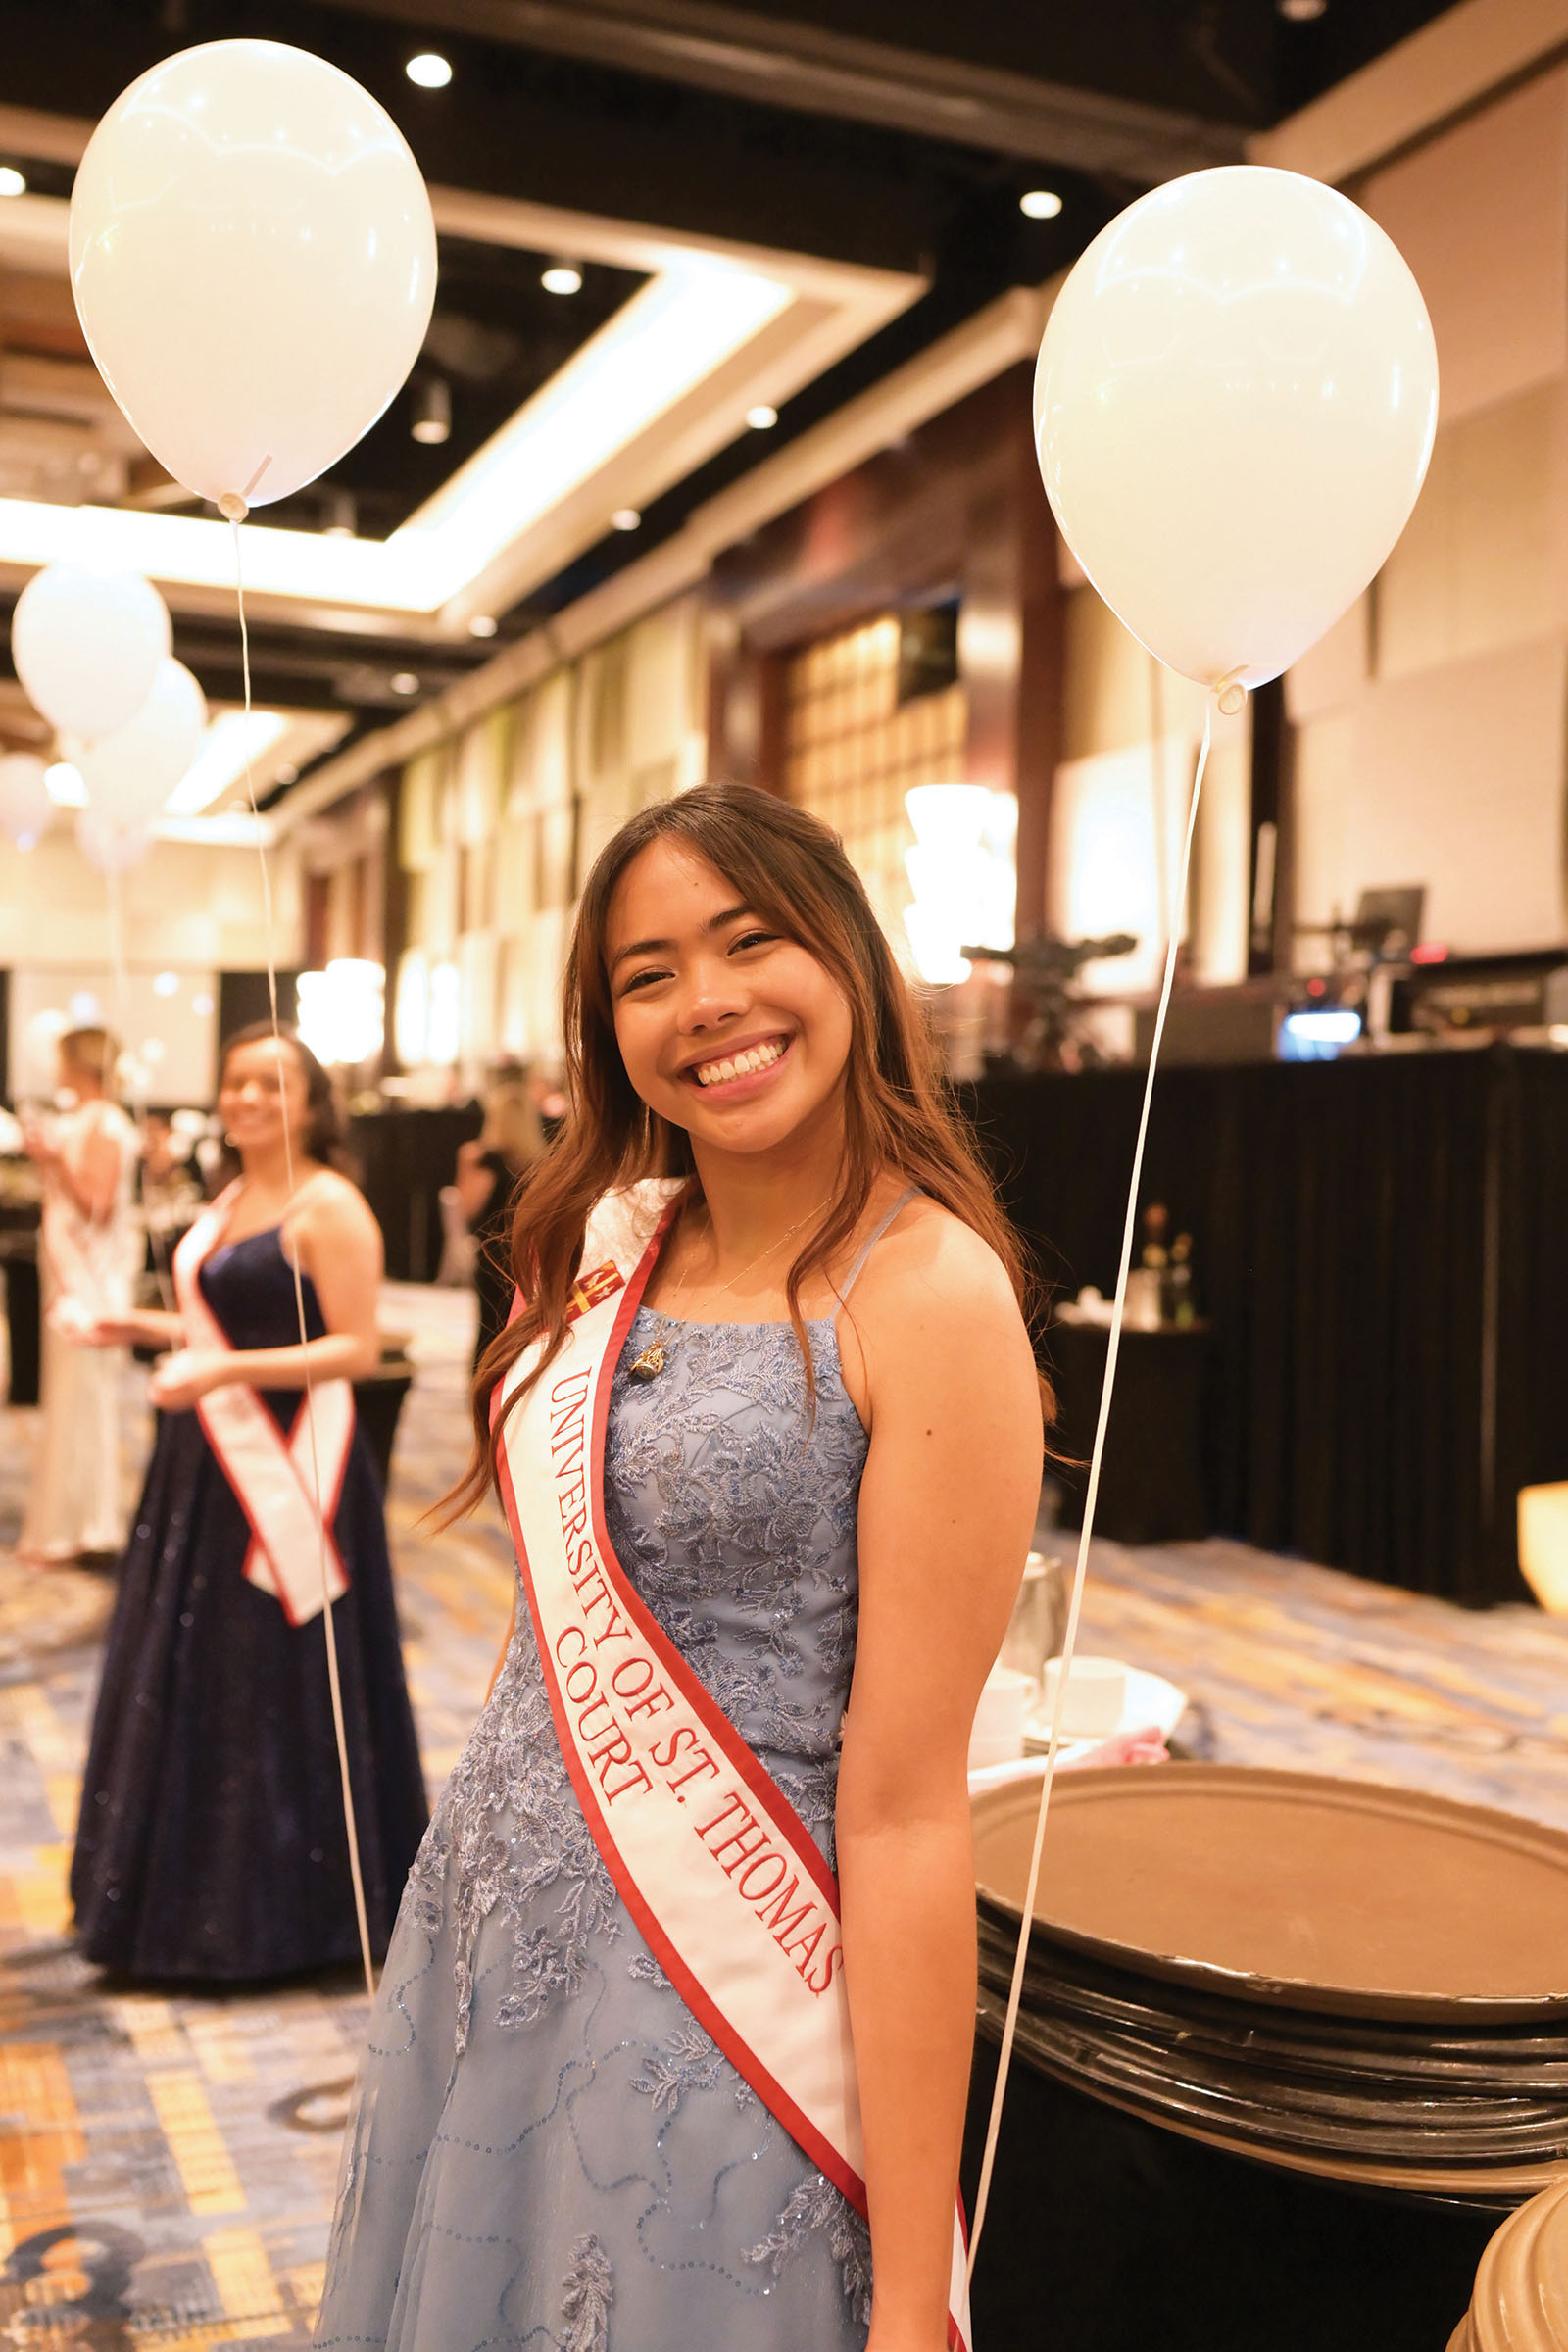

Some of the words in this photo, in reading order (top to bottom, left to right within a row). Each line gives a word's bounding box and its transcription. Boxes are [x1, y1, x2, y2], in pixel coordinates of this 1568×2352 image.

[551, 1367, 632, 1651] UNIVERSITY
[612, 1656, 675, 1720] OF
[649, 1728, 720, 1803] ST.
[693, 1790, 844, 1997] THOMAS
[556, 1626, 653, 1806] COURT
